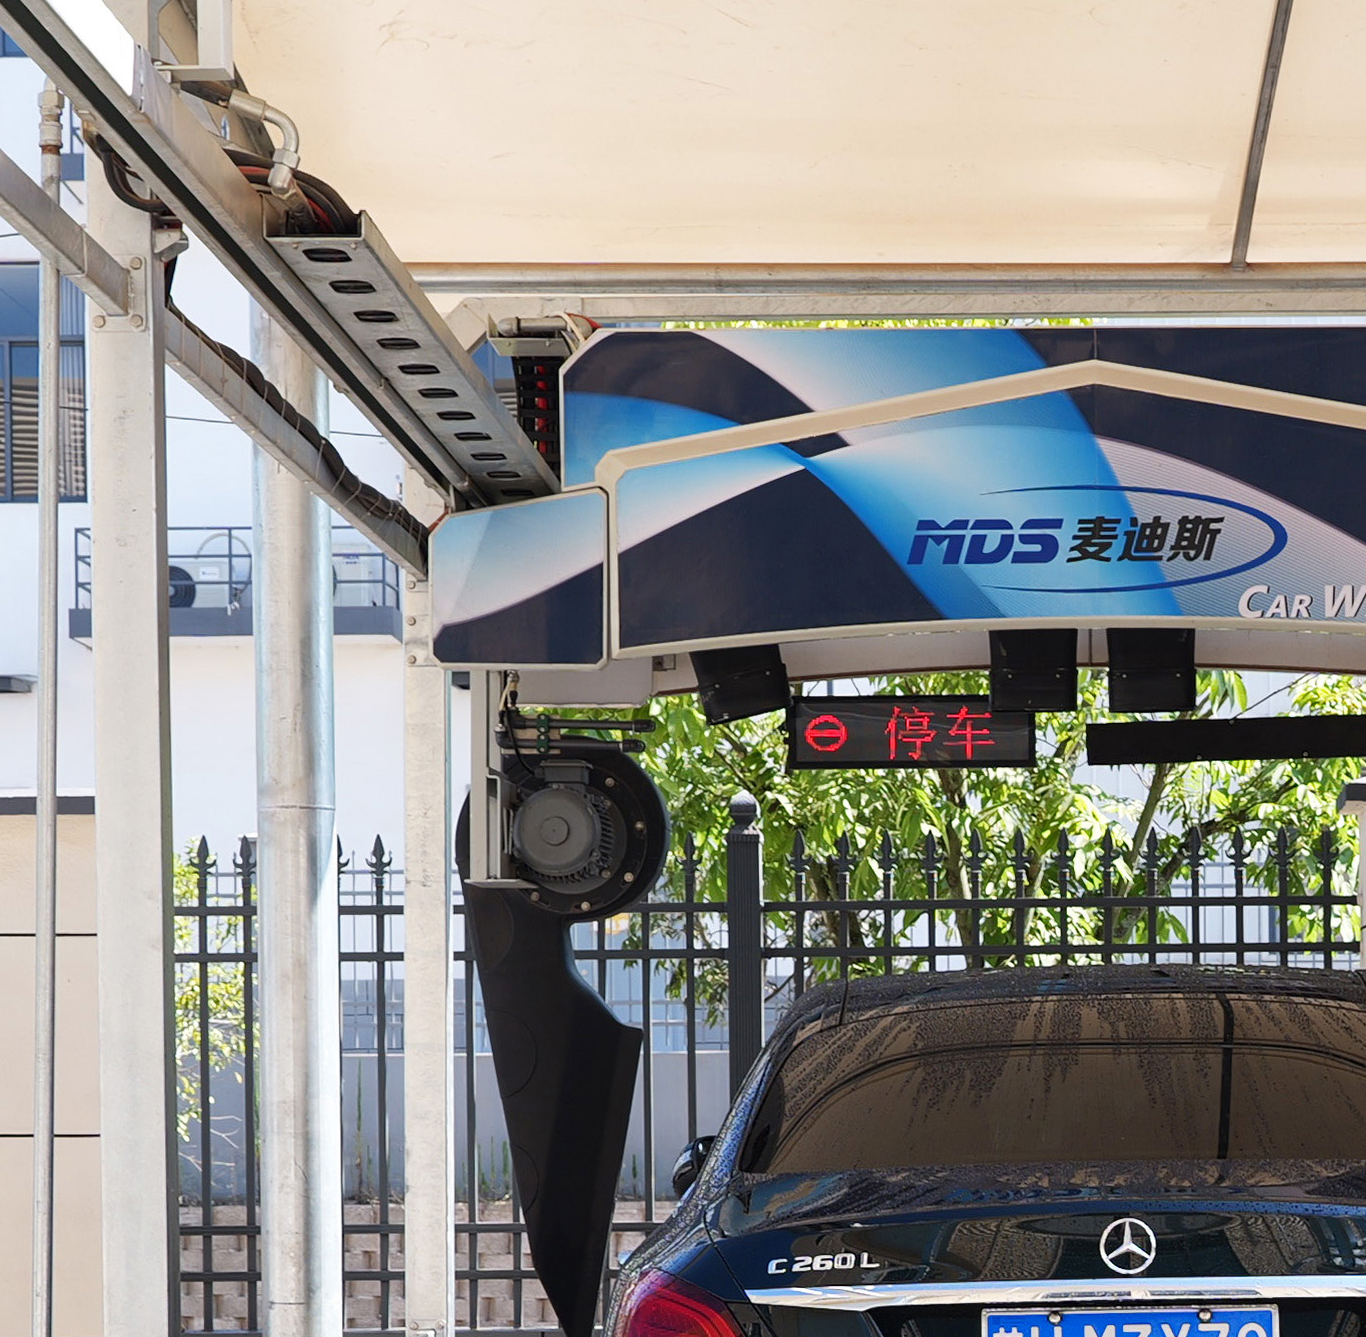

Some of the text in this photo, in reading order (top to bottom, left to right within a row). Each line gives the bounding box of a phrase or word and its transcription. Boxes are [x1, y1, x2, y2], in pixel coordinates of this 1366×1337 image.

[906, 515, 1226, 565] MDS 麦迪斯
[885, 705, 996, 760] 停车
